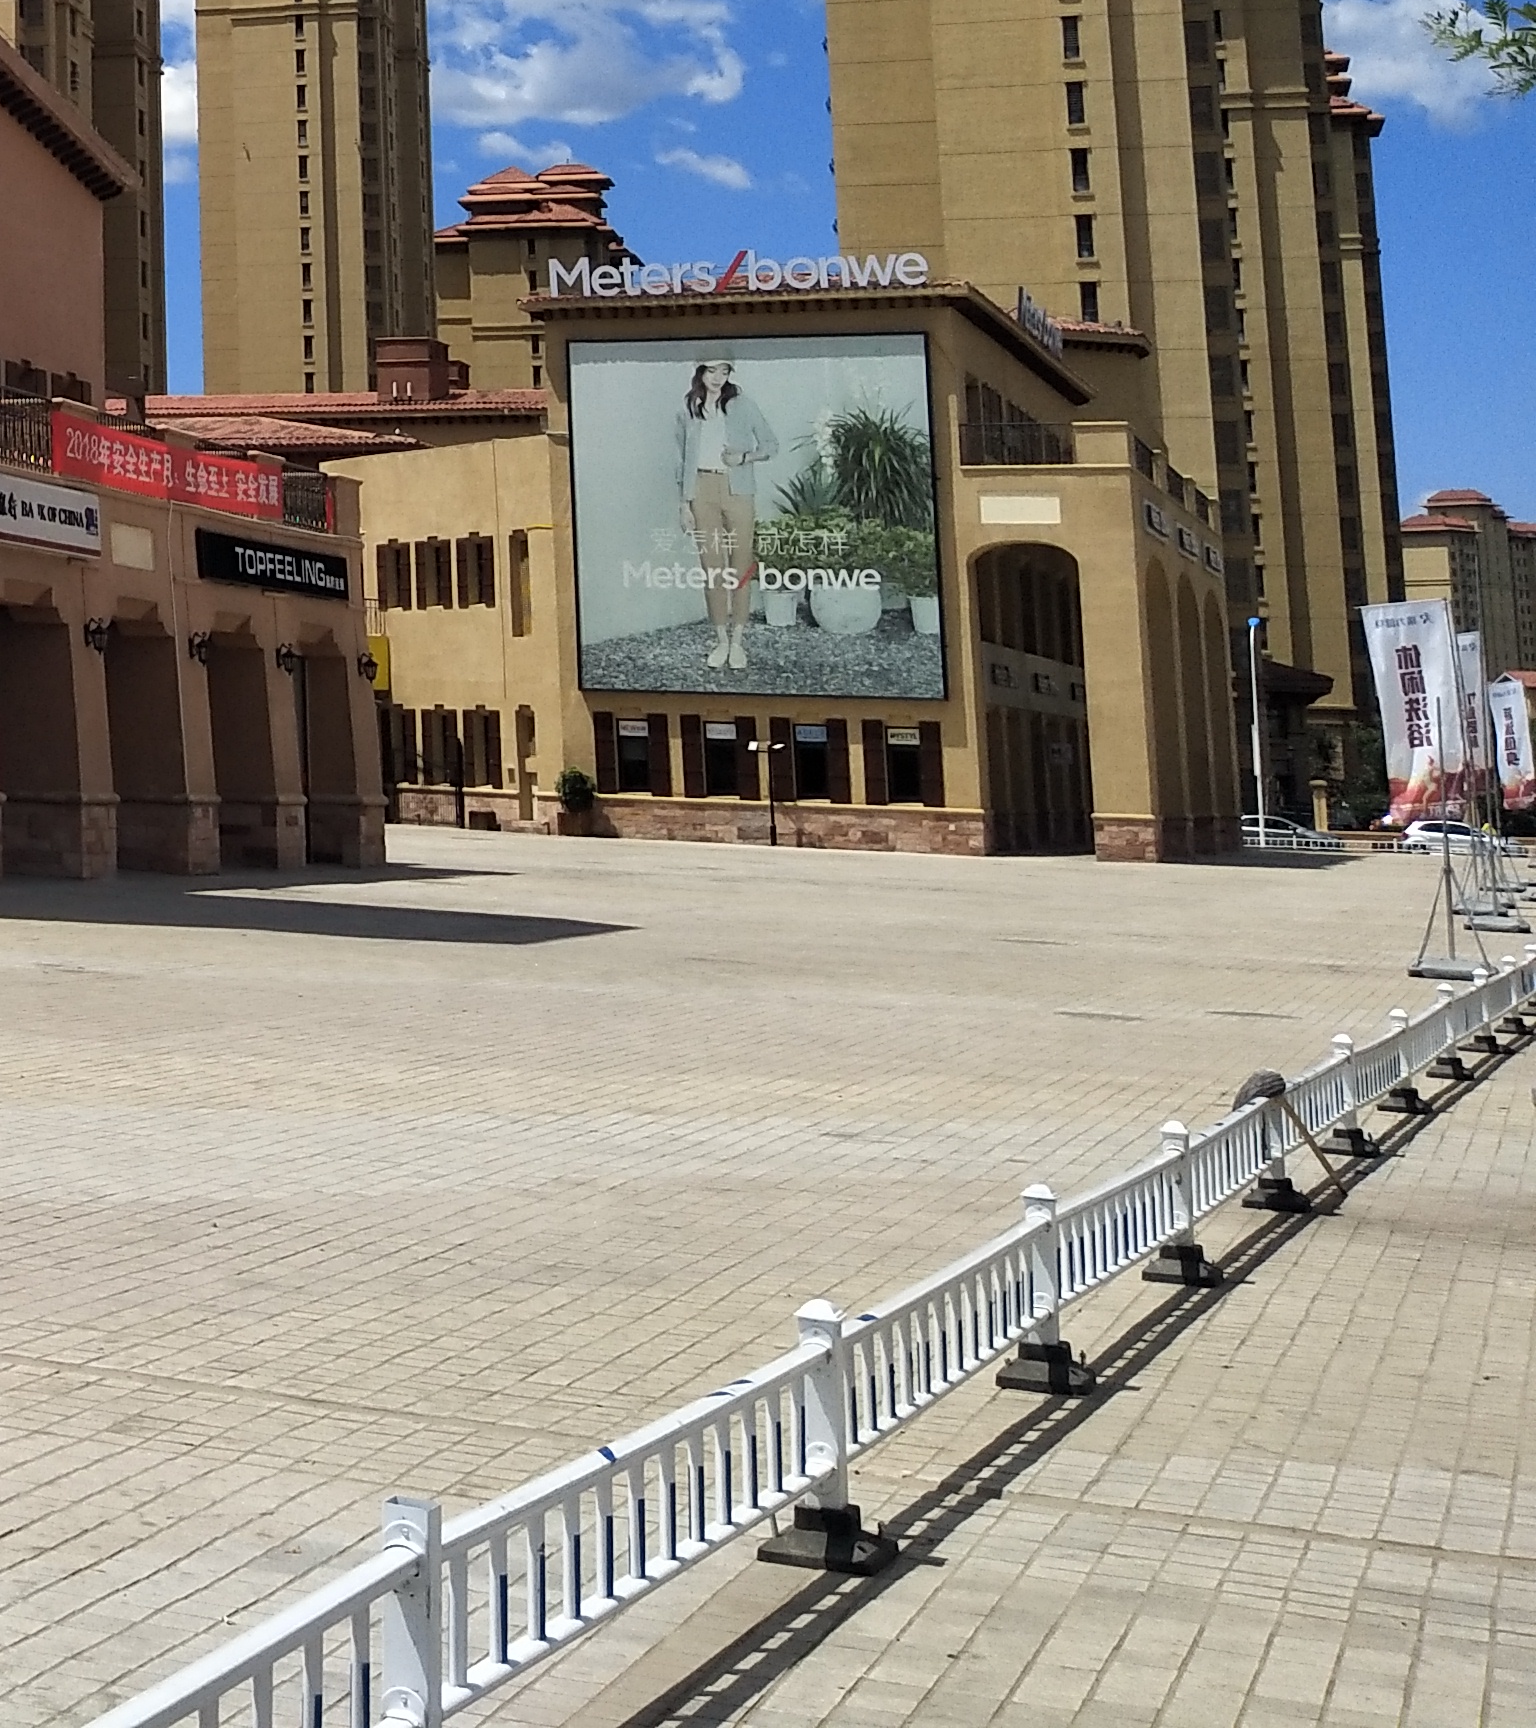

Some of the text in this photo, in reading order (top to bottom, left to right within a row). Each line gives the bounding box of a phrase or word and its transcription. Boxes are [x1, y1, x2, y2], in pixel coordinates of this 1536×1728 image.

[58, 508, 84, 529] CHINA
[650, 527, 849, 557] 爱怎样 就怎样
[235, 546, 325, 587] TOPFEELING
